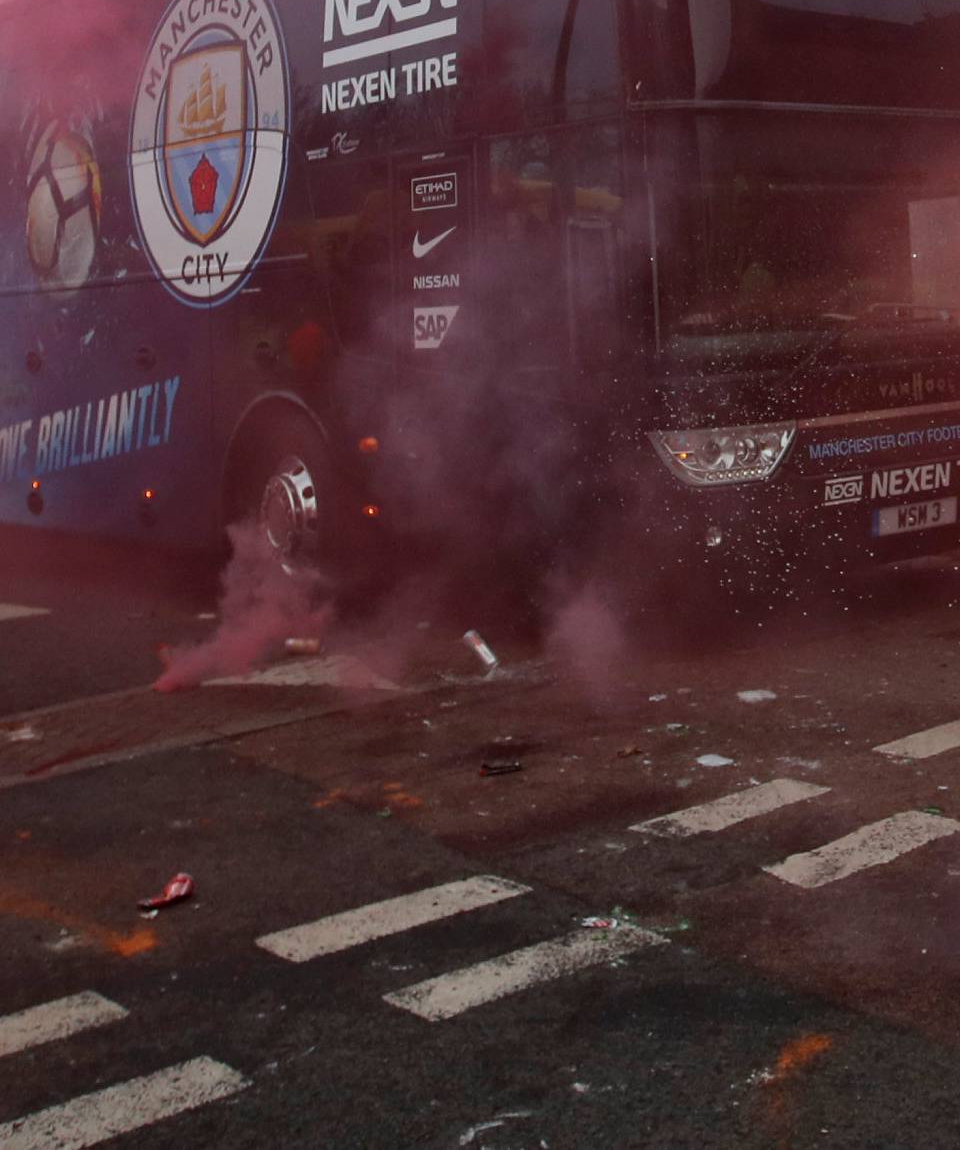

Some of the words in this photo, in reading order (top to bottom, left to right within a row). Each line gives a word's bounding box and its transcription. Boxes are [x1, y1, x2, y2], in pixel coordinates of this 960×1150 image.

[321, 67, 396, 114] NEXEN
[402, 52, 458, 96] TIRE
[415, 181, 453, 194] ETIHAD
[181, 252, 228, 284] CITY
[413, 274, 460, 290] NISSAN
[415, 314, 448, 341] SAP
[35, 375, 180, 477] BRILLIANTLY
[808, 435, 896, 459] MANCHESTER
[898, 431, 925, 446] CITY
[825, 480, 863, 501] NEXEN
[871, 462, 950, 498] NEXEN
[898, 506, 928, 529] WSM
[931, 502, 942, 527] 3
